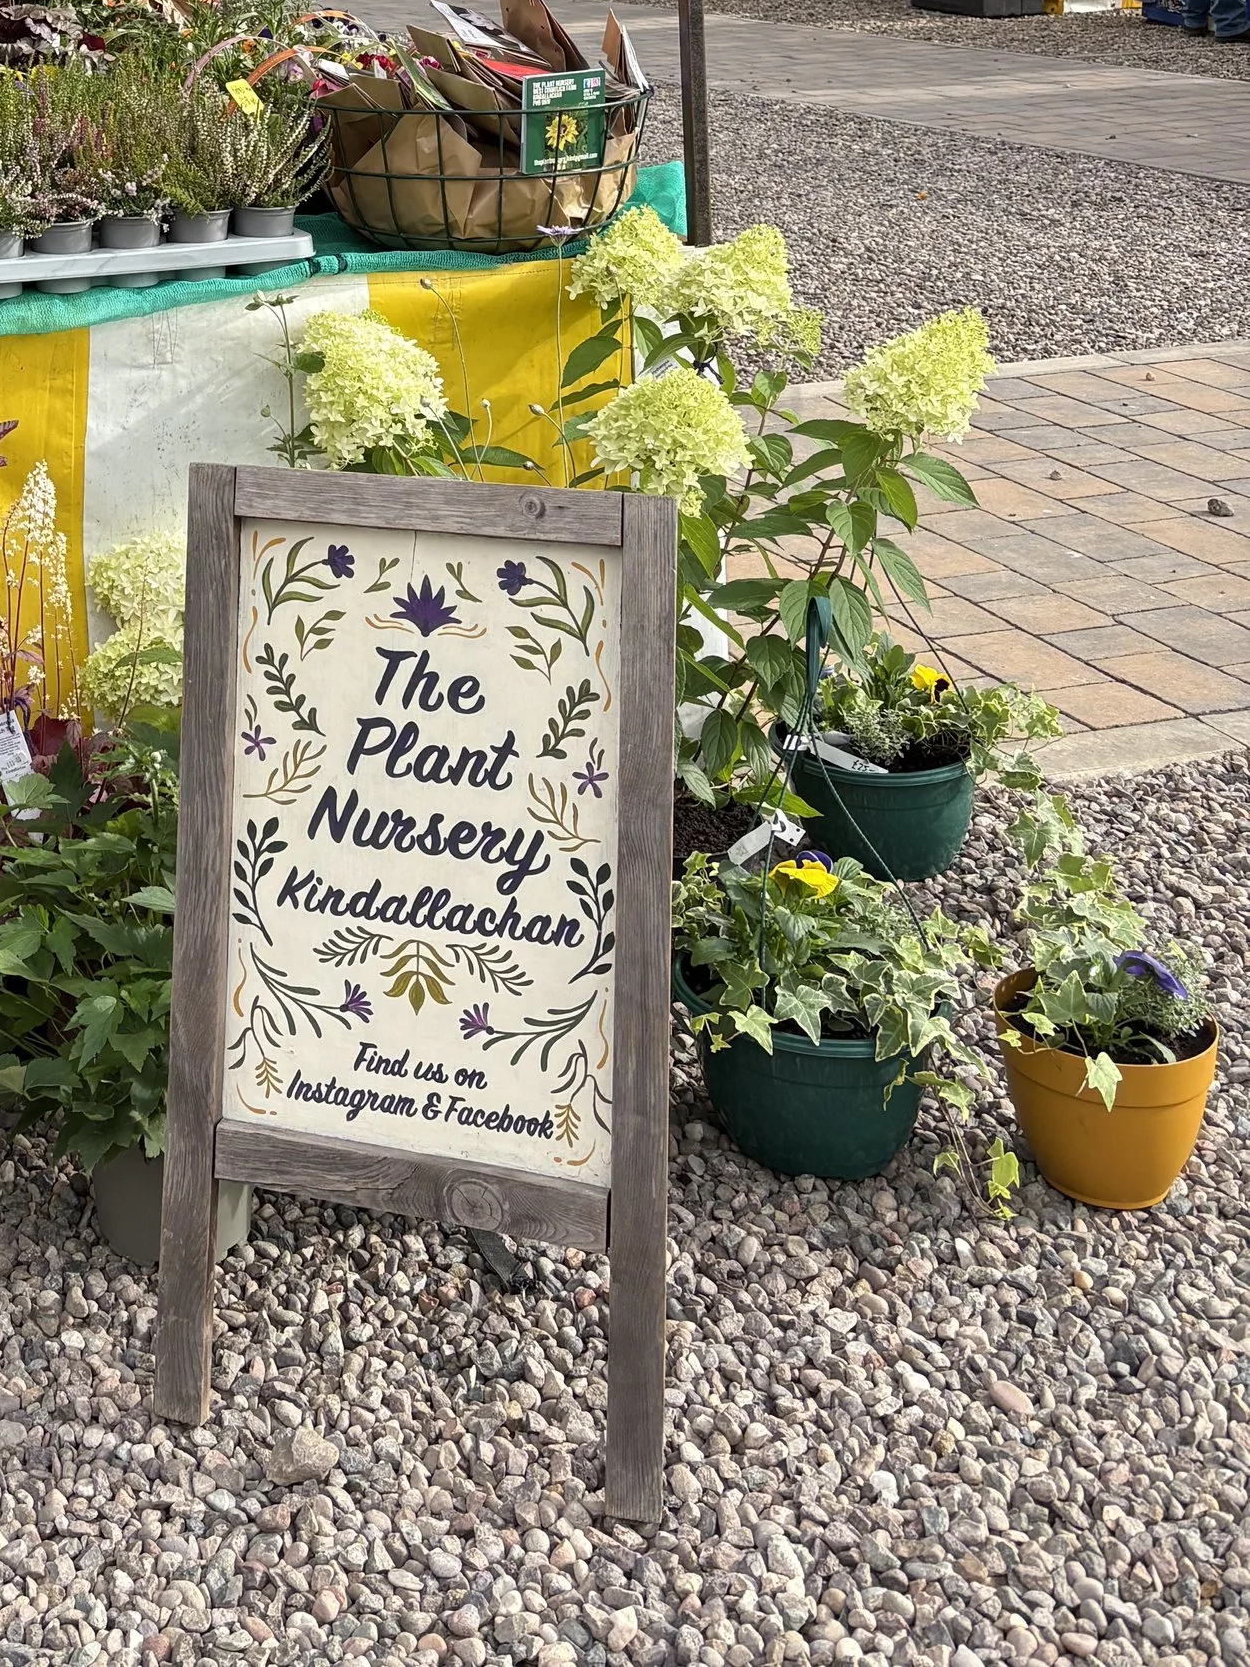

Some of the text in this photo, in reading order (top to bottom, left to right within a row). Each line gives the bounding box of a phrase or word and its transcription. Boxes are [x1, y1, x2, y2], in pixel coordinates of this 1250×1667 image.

[374, 646, 486, 715] The
[346, 716, 520, 791] Plant
[306, 785, 551, 896] Nursery
[276, 865, 585, 948] Kindallachan
[353, 1041, 488, 1091] Find us on
[286, 1069, 554, 1139] Instagram & Facebook
